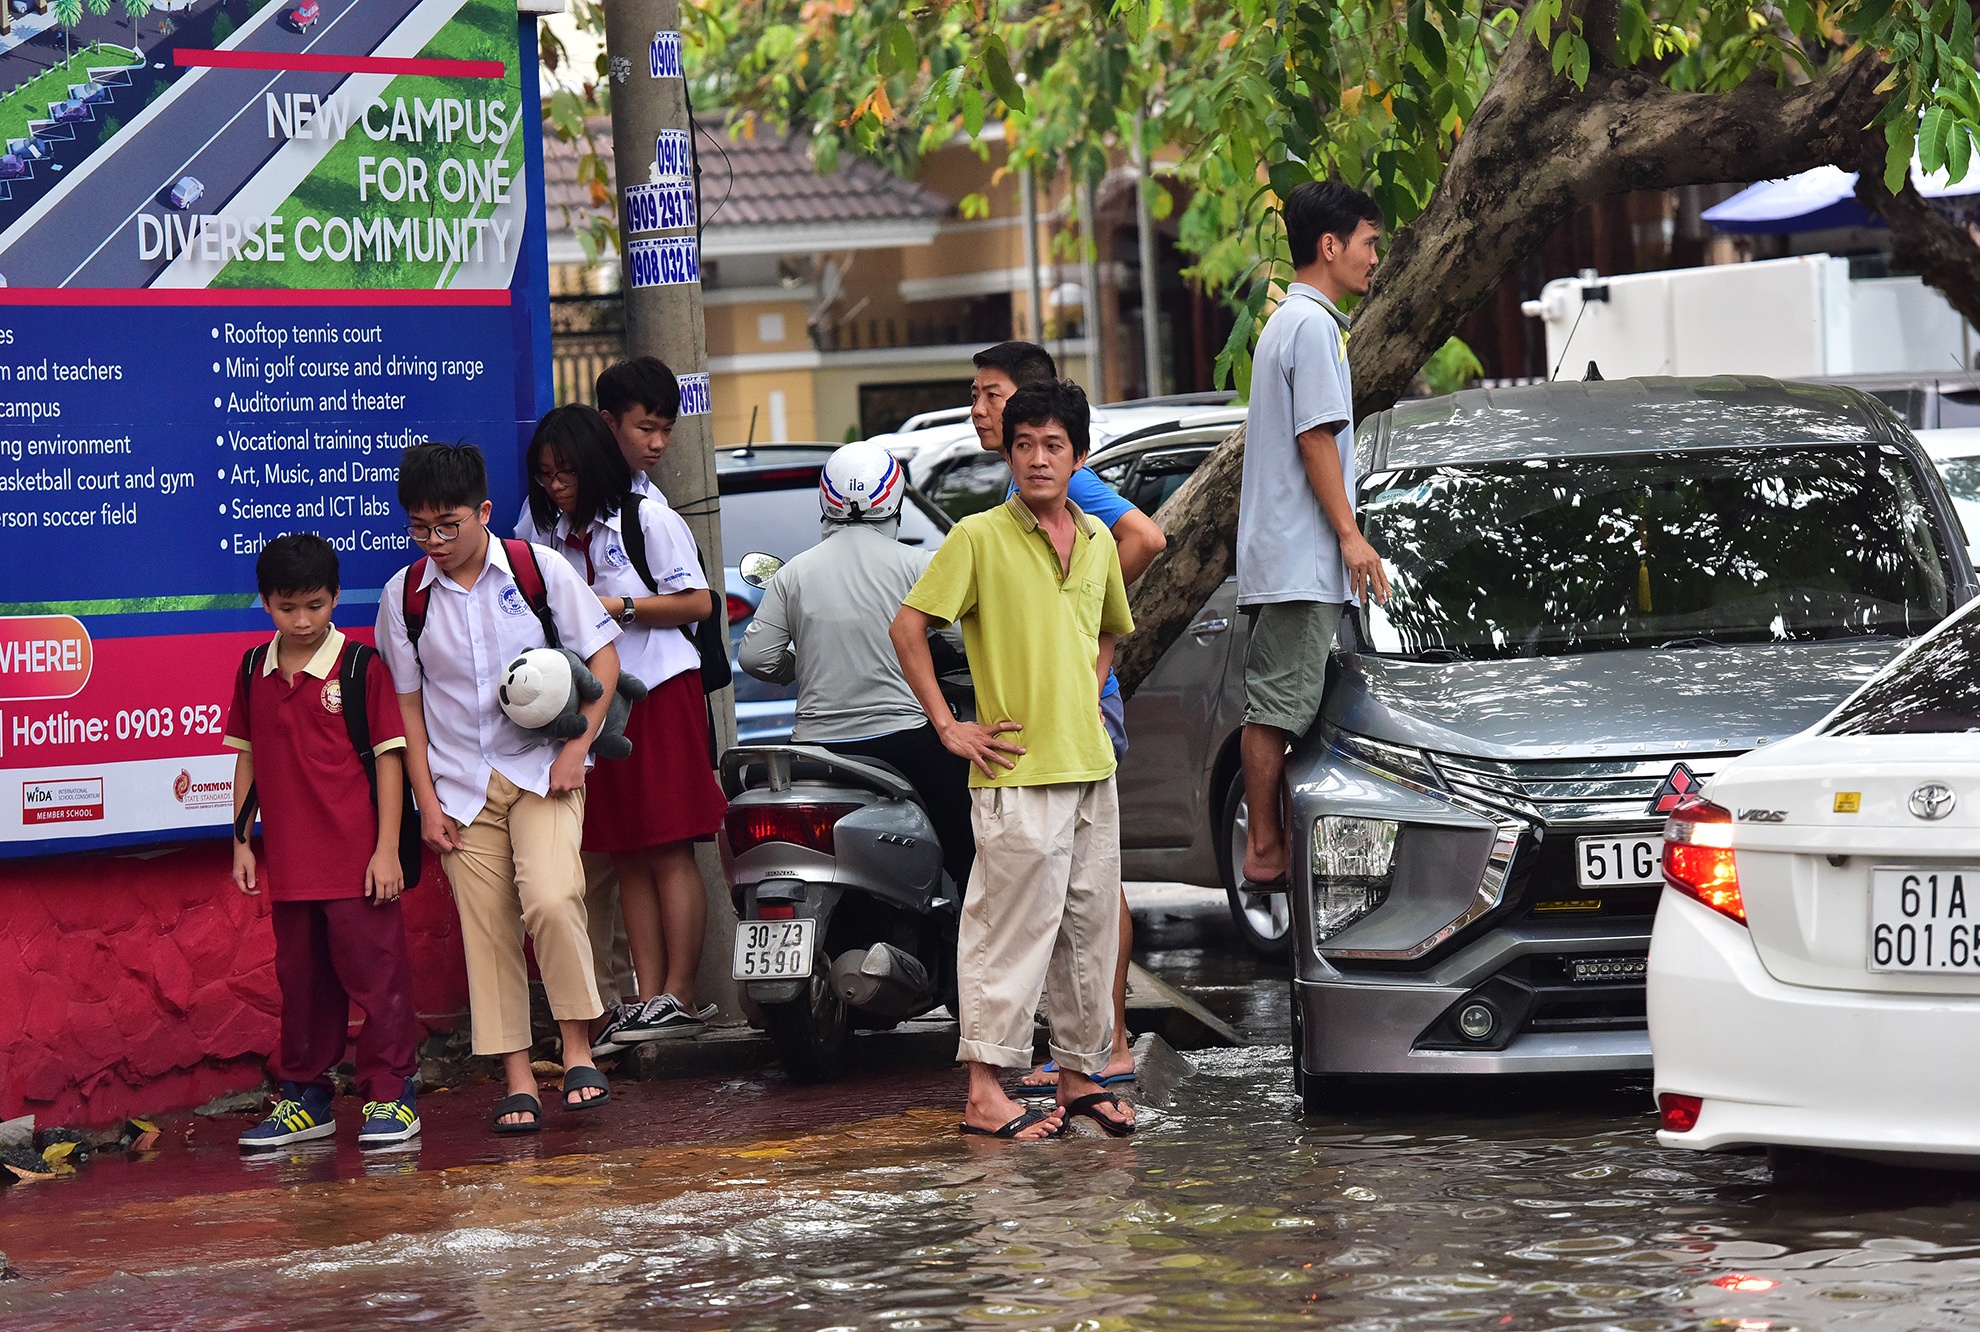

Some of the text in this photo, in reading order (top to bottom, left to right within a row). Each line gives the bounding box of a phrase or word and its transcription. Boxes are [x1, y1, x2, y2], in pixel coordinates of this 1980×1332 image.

[266, 92, 508, 145] NEW CAMPUS
[358, 156, 511, 204] FOR ONE
[138, 213, 512, 263] DIVERSE COMMUNITY
[224, 321, 382, 349] Rooftop tennis court
[17, 358, 47, 381] and
[53, 358, 123, 381] teachers
[226, 355, 484, 383] Mini golf course and driving range
[0, 401, 61, 423] campus
[227, 389, 406, 413] Auditorium and theater
[1, 434, 131, 461] ng environment
[228, 428, 429, 454] Vocational training studios
[0, 466, 195, 494] asketball court and gym
[231, 461, 400, 487] Art, Music, and Drama
[849, 478, 865, 491] ila
[0, 502, 137, 528] rson soccer field
[232, 494, 390, 519] Science and ICT labs
[361, 530, 411, 550] Center
[13, 704, 222, 746] Hotline: 0903 952
[191, 781, 232, 793] COMMON
[37, 809, 93, 820] MEMBER SCHOOL
[1737, 808, 1789, 823] VIOS
[1901, 874, 1967, 918] 61A
[747, 923, 803, 949] 30-Z3
[744, 950, 801, 975] 5590
